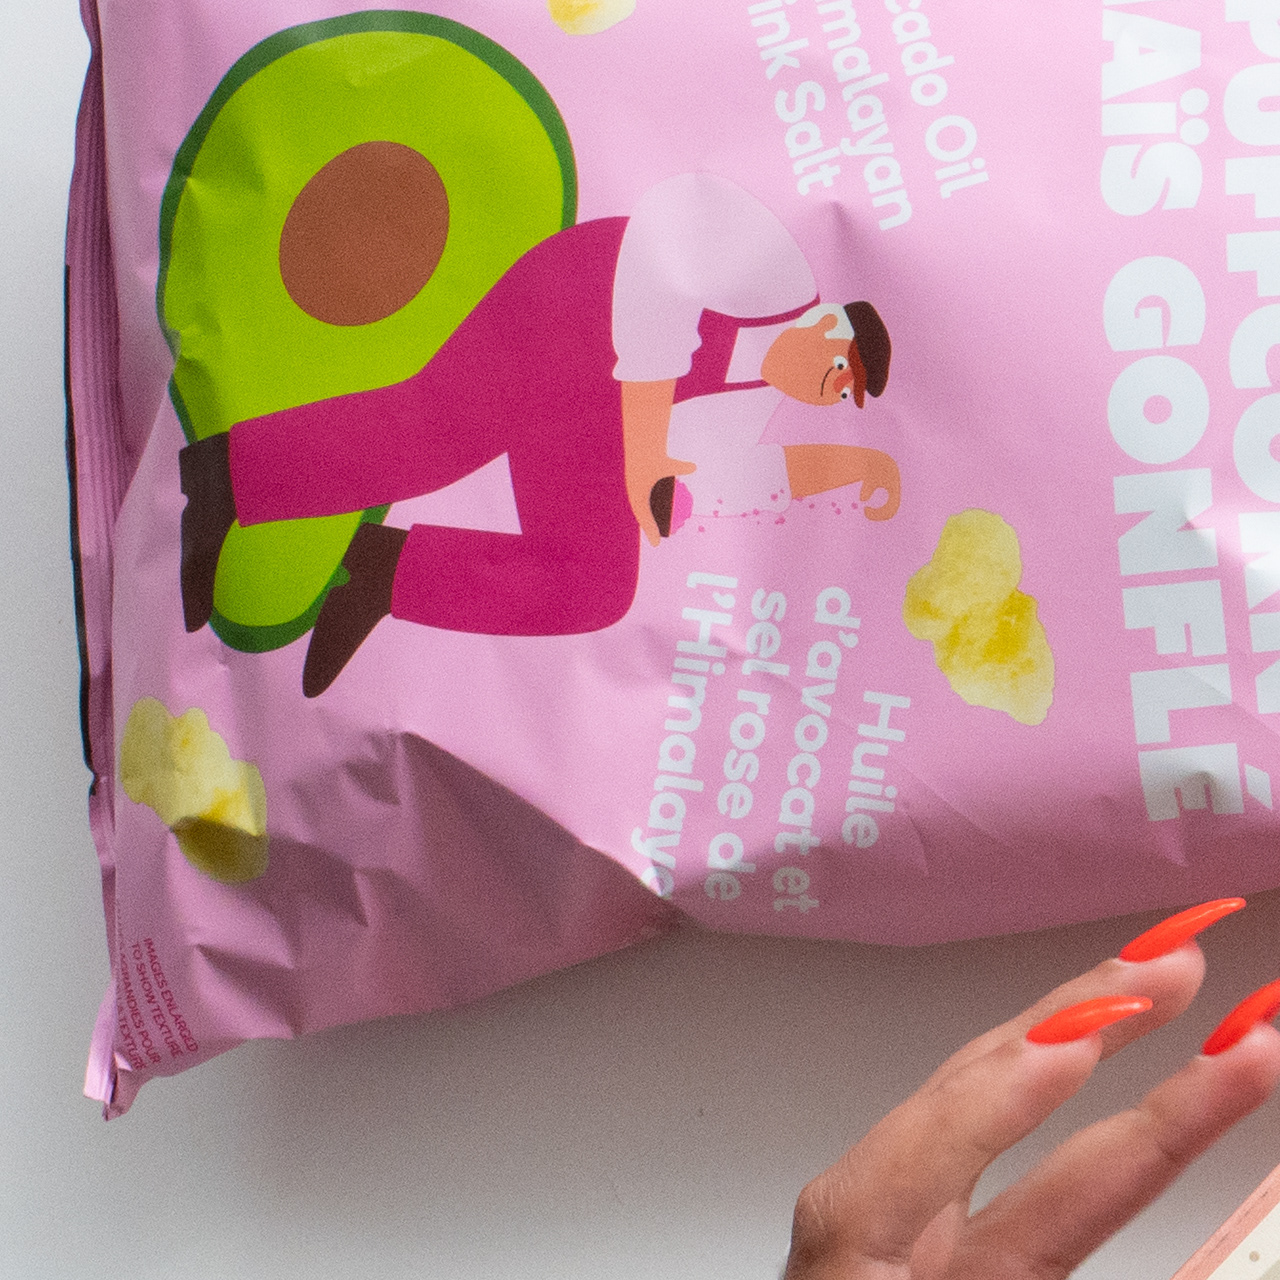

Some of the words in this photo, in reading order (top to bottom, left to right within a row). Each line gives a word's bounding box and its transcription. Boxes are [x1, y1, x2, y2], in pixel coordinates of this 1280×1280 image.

[774, 80, 841, 196] Salt
[924, 114, 989, 199] Oil
[1101, 255, 1273, 822] GONFLÉ
[741, 588, 790, 676] sel
[717, 689, 771, 819] rose
[773, 586, 861, 855] d'avocat
[841, 690, 911, 848] Huile
[704, 832, 756, 901] de
[772, 866, 820, 913] et
[131, 943, 142, 961] TO
[136, 962, 157, 1004] SHOW
[143, 937, 168, 989] IMAGES
[161, 989, 199, 1053] ENLARGED
[138, 1030, 161, 1064] POUR
[152, 1004, 184, 1058] TEXTURE
